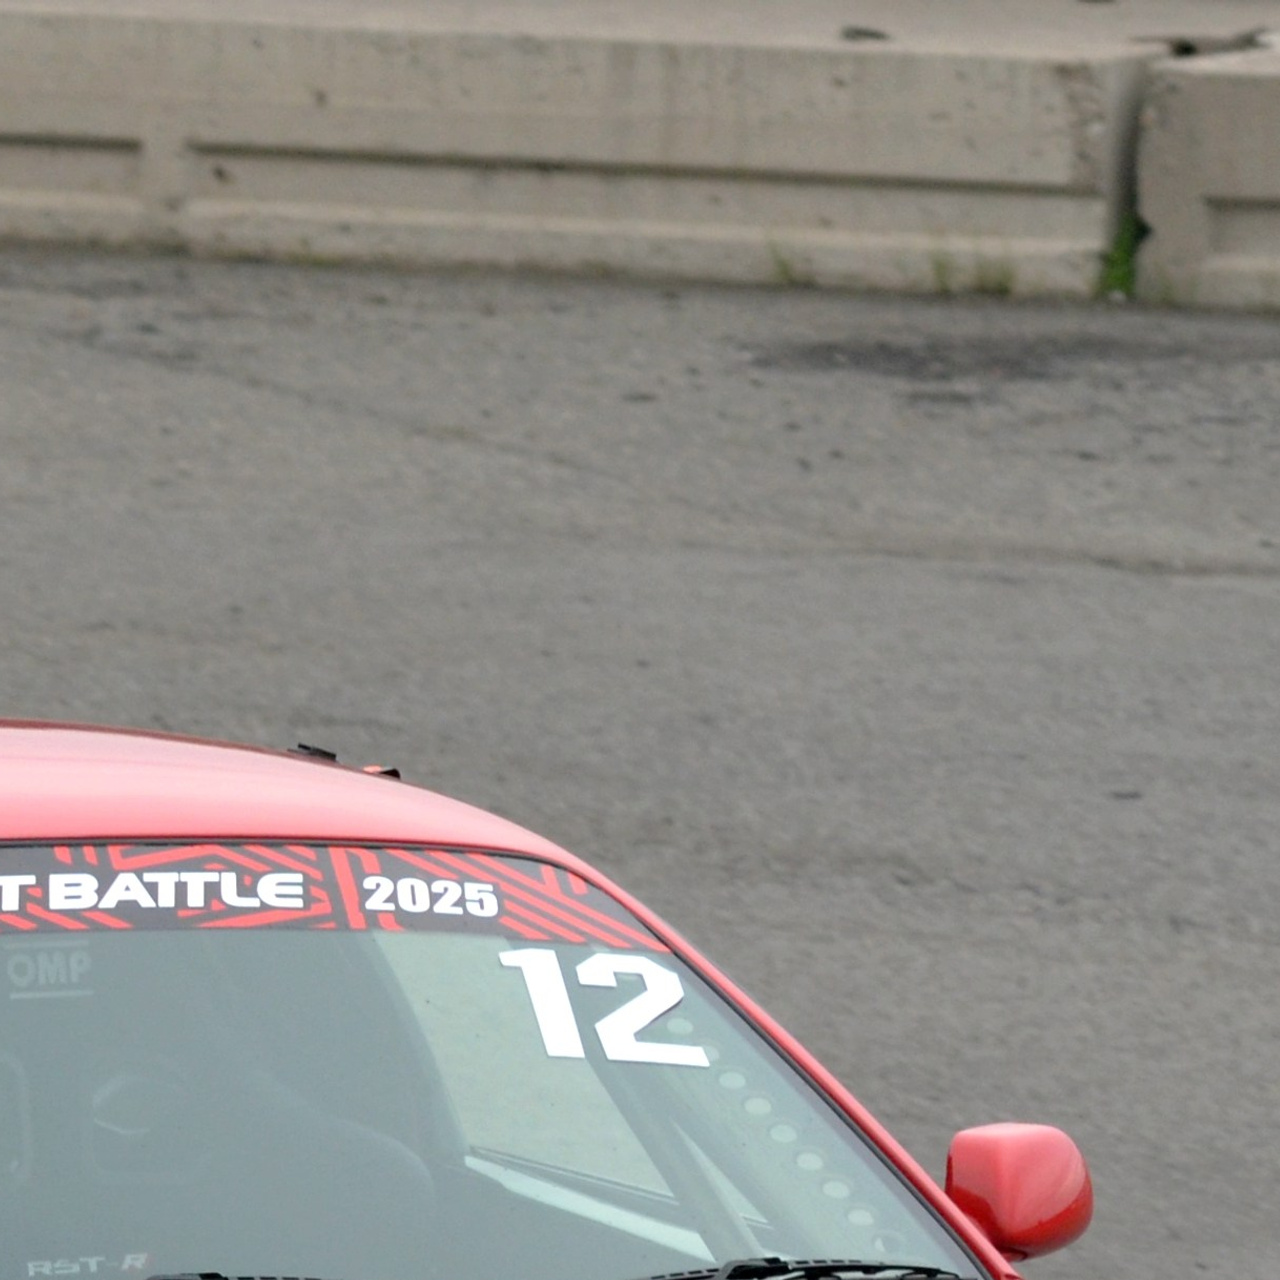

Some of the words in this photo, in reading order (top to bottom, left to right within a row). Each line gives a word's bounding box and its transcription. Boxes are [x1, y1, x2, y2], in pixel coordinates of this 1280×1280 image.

[48, 871, 304, 910] BATTLE
[362, 875, 499, 918] 2025
[6, 950, 93, 988] OMP
[498, 948, 710, 1067] 12
